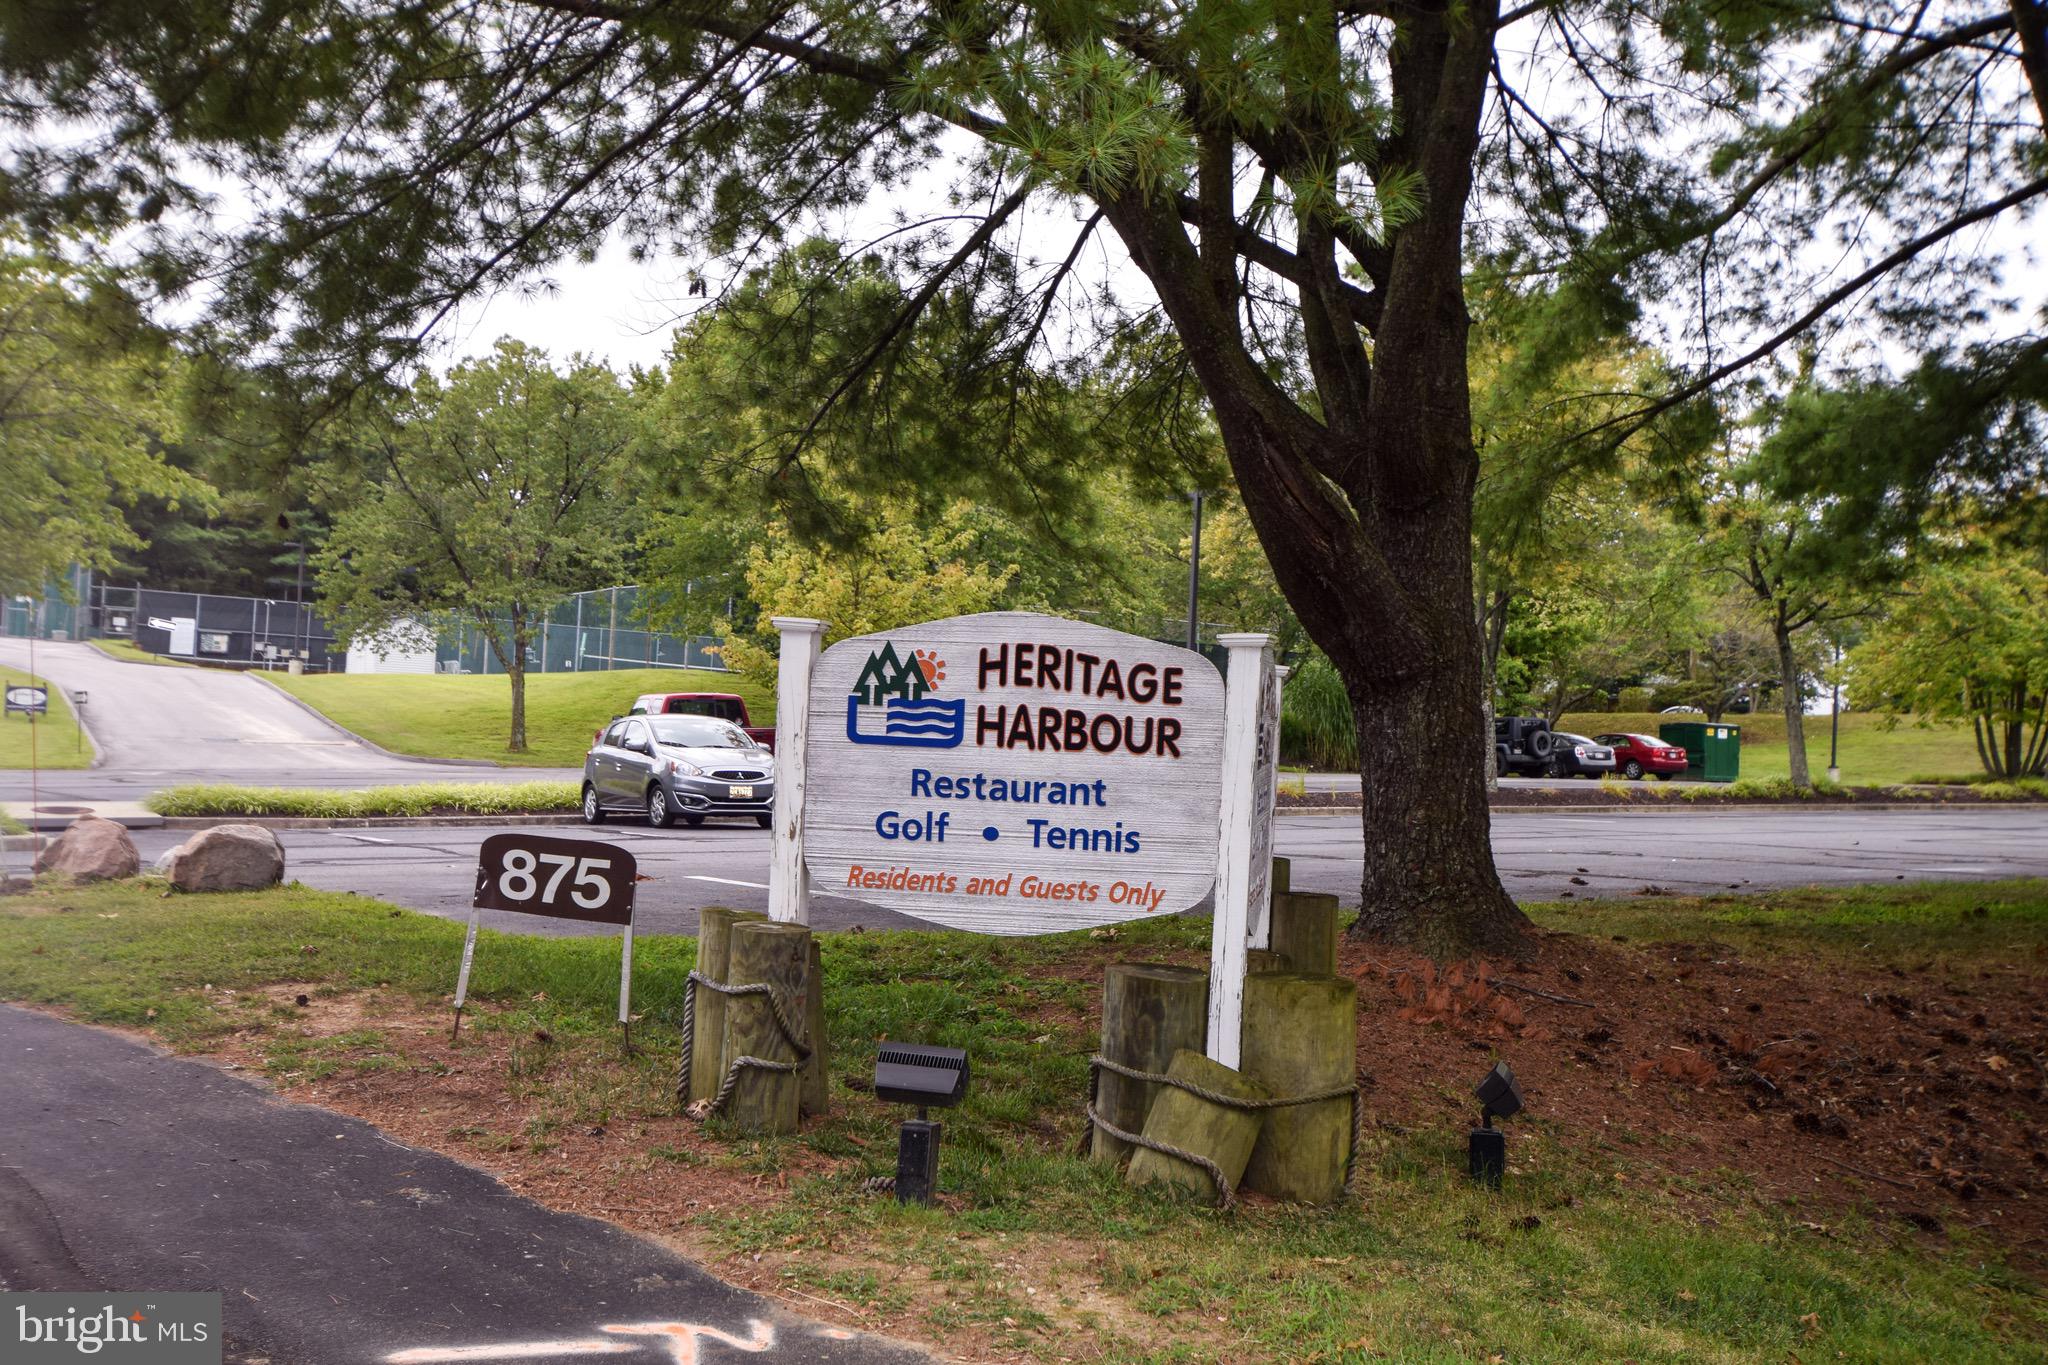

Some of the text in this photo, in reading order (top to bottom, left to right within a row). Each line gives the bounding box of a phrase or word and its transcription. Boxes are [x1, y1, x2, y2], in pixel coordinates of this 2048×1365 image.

[978, 643, 1184, 705] HERITAGE
[976, 704, 1181, 758] HARBOUR
[911, 768, 1106, 806] Restaurant
[875, 811, 1140, 853] Golf Tennis
[499, 849, 611, 909] 875
[847, 865, 1166, 911] Residents and Guests Only
